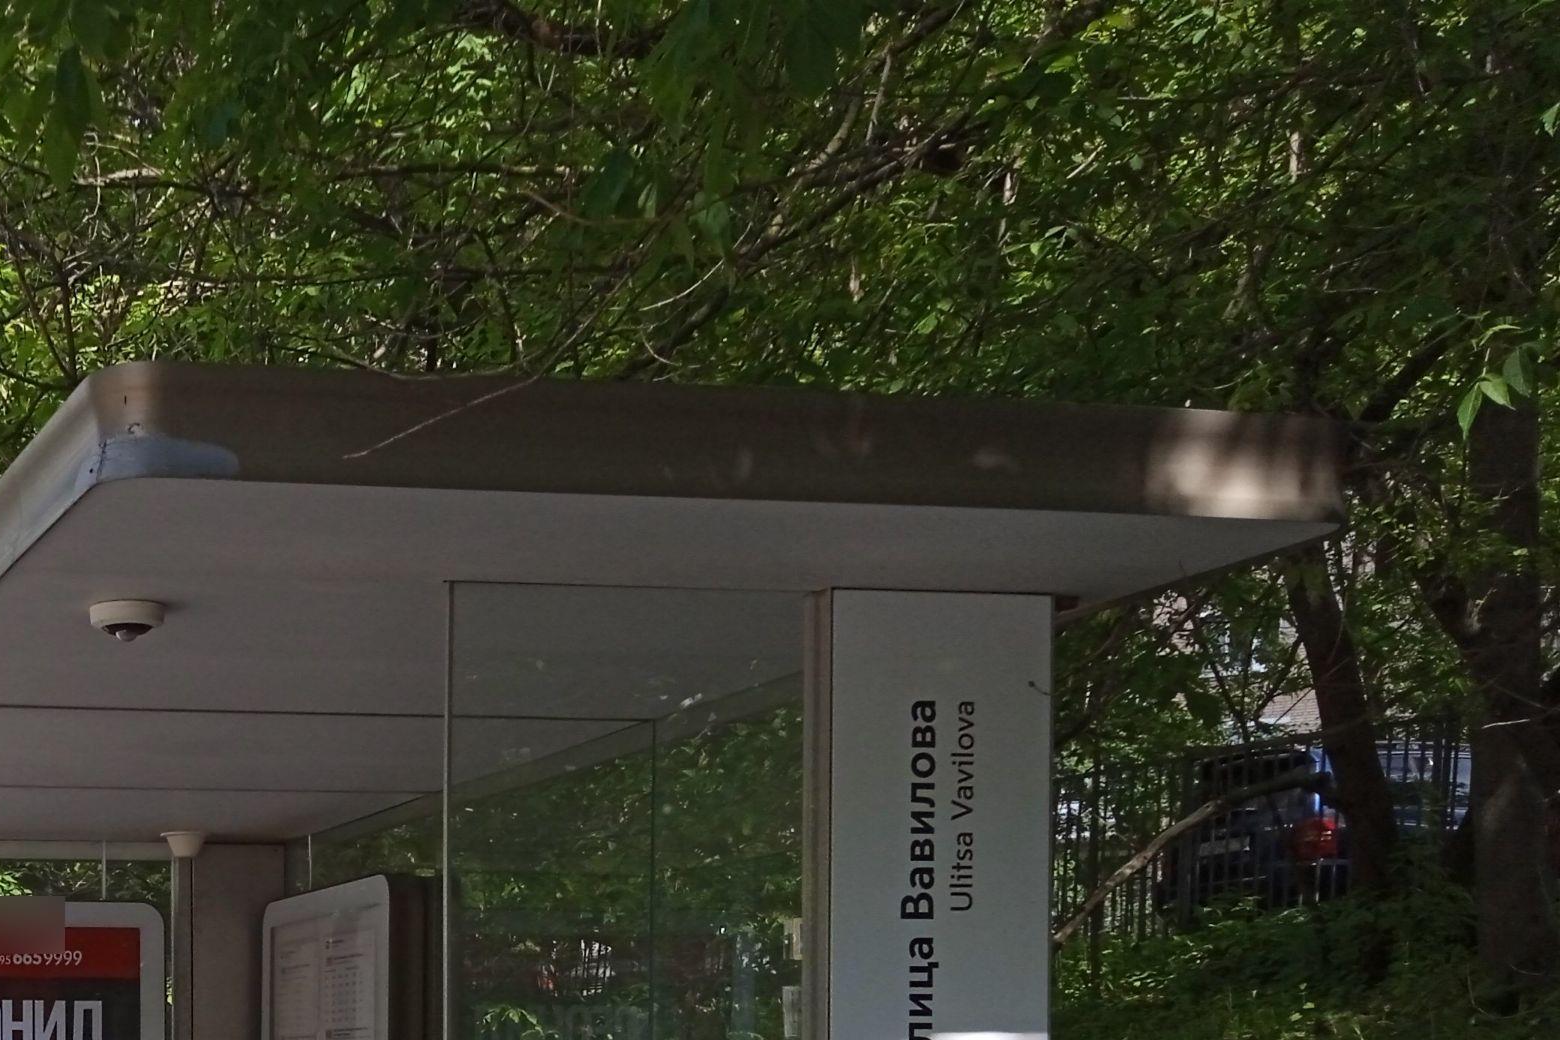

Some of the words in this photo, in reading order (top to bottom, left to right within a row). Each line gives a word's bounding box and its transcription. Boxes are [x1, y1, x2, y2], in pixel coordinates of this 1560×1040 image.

[900, 700, 937, 920] Вавилова
[950, 701, 975, 821] Vavilova
[950, 832, 974, 911] Ulitsa
